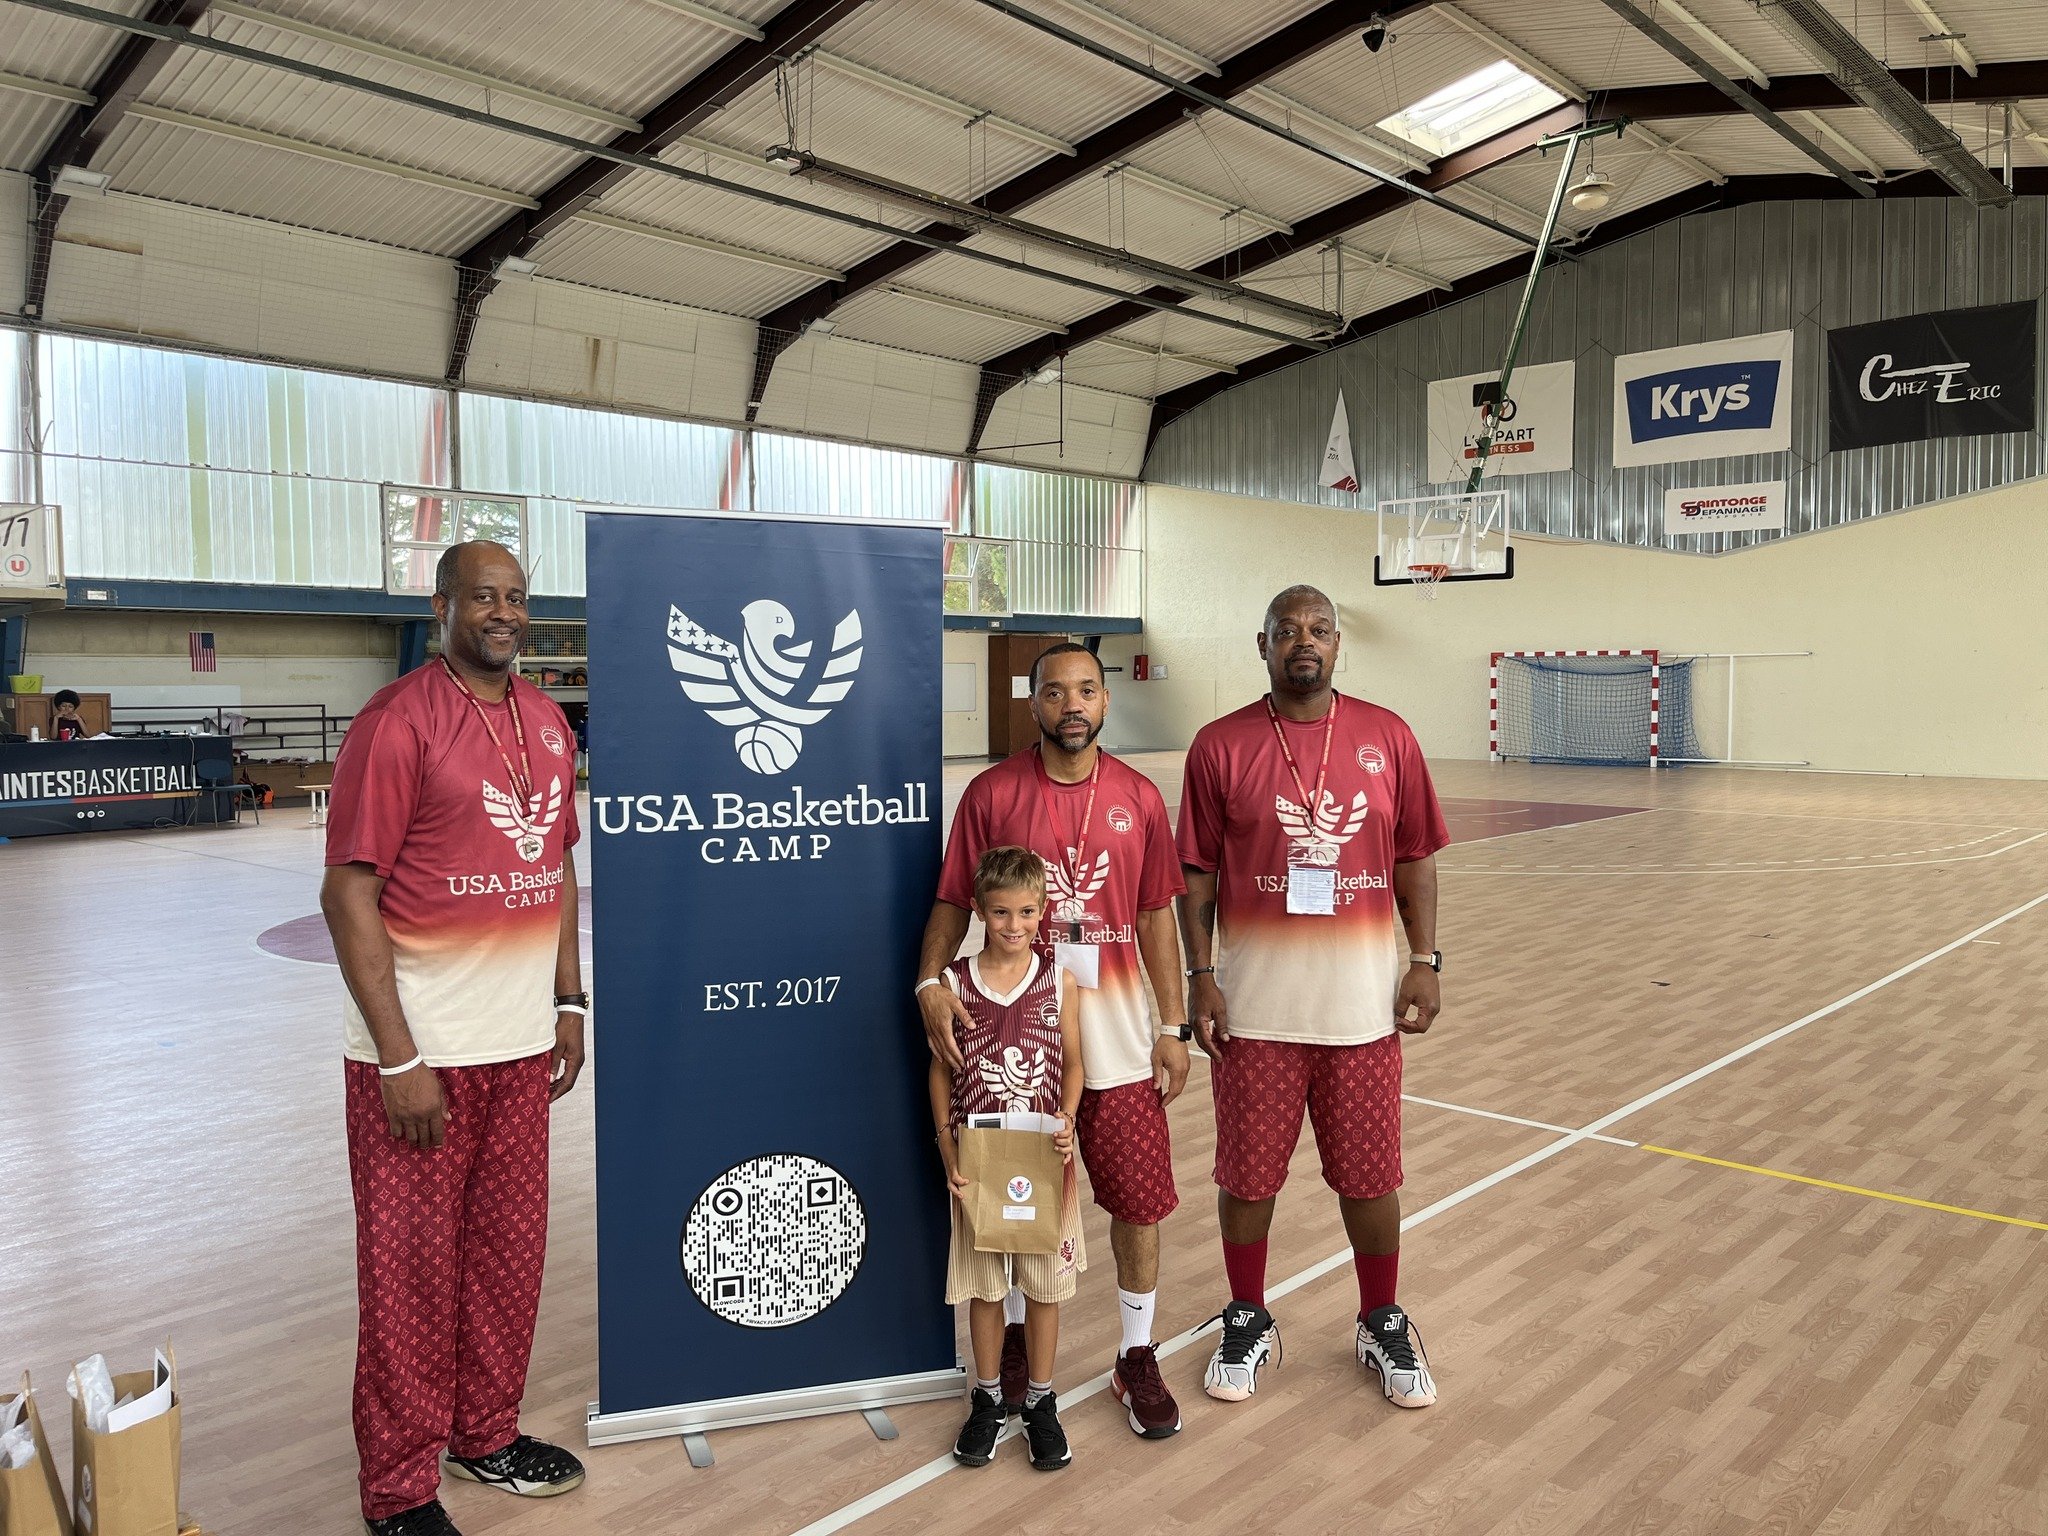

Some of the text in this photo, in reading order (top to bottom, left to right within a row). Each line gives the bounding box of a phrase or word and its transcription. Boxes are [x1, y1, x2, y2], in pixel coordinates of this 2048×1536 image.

[1651, 383, 1750, 423] Krys
[1681, 496, 1767, 514] SAINTONGE
[1686, 505, 1767, 517] DEPANNAGE
[776, 616, 784, 624] D
[593, 782, 930, 834] USA Basketball
[701, 834, 831, 864] CAMP
[446, 874, 507, 896] USA
[504, 888, 556, 909] CAMP
[1047, 924, 1131, 945] Baketball
[703, 975, 841, 1012] EST. 2017
